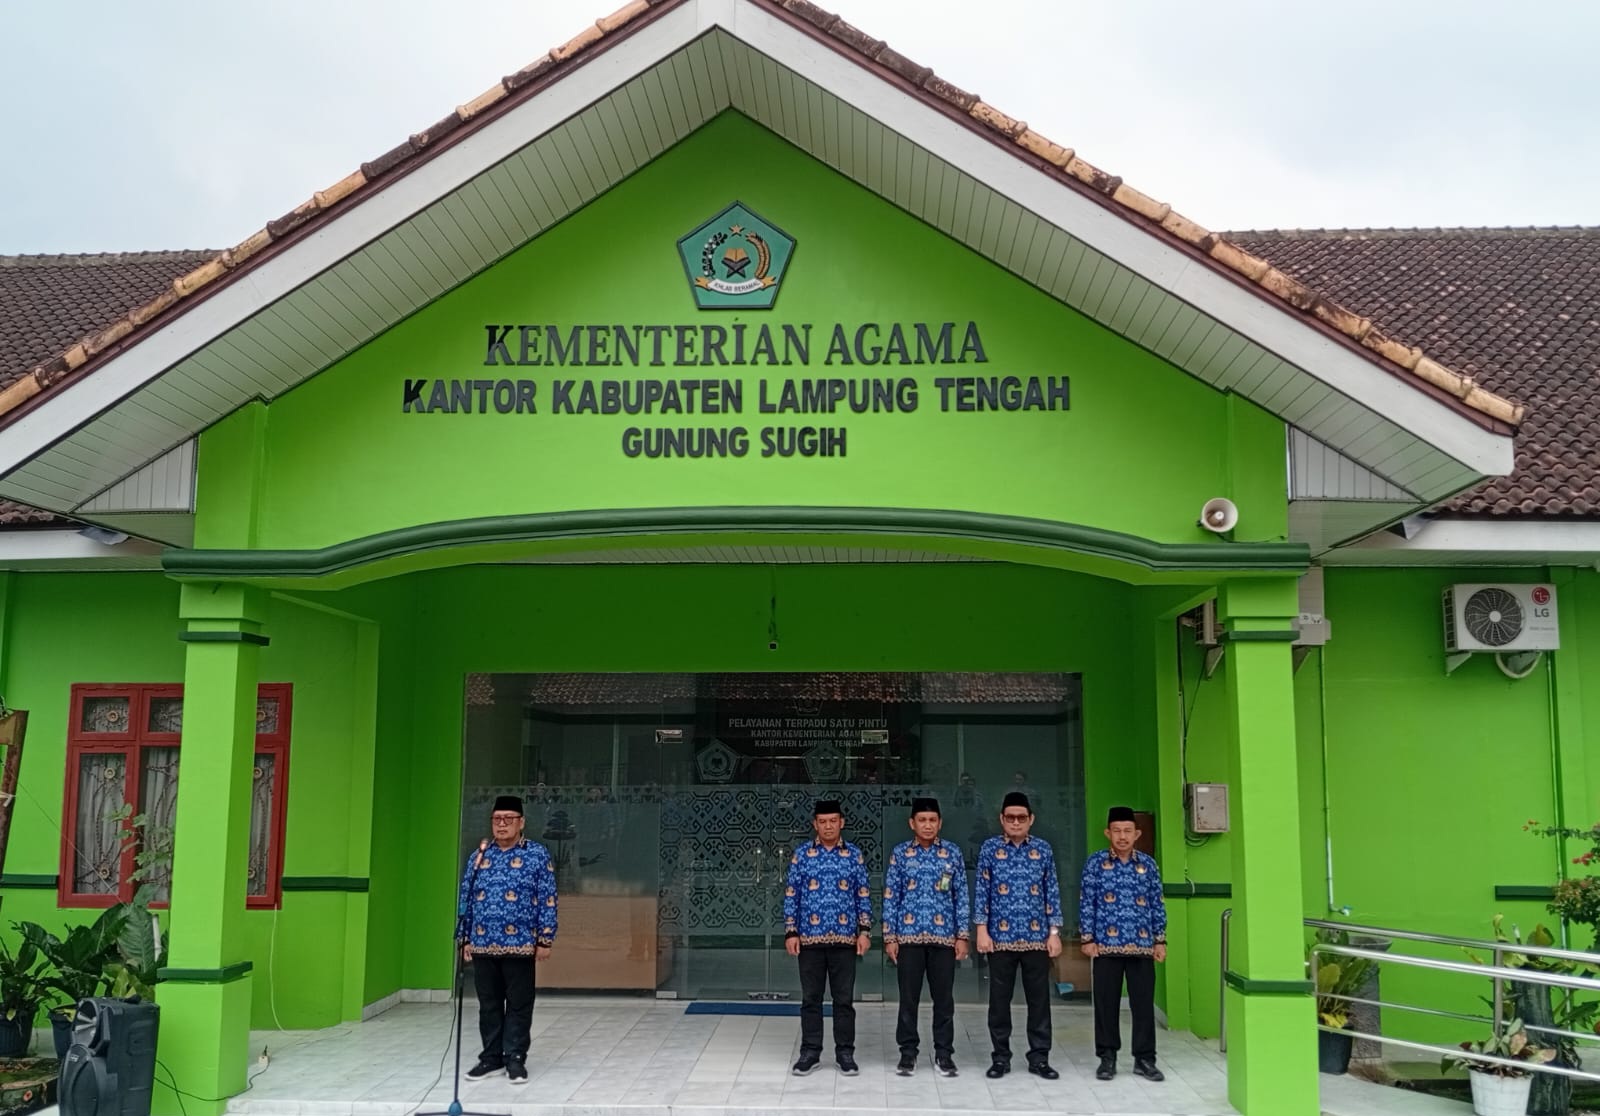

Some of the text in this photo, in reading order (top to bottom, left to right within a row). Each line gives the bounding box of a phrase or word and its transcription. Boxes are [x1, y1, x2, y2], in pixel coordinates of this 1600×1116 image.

[484, 321, 988, 367] KEMENTERIAN AGAMA
[403, 376, 1070, 415] KANTOR KABUPATEN LAMPUNG TENGAH
[622, 426, 847, 458] GUNUNG SUGIH
[1534, 608, 1550, 618] LG
[728, 718, 888, 728] PELAYANAN TERPADU SATU PINTU
[751, 729, 861, 738] KANTOR KEMENTERIAN AGAM
[754, 739, 797, 748] KABUPATEN
